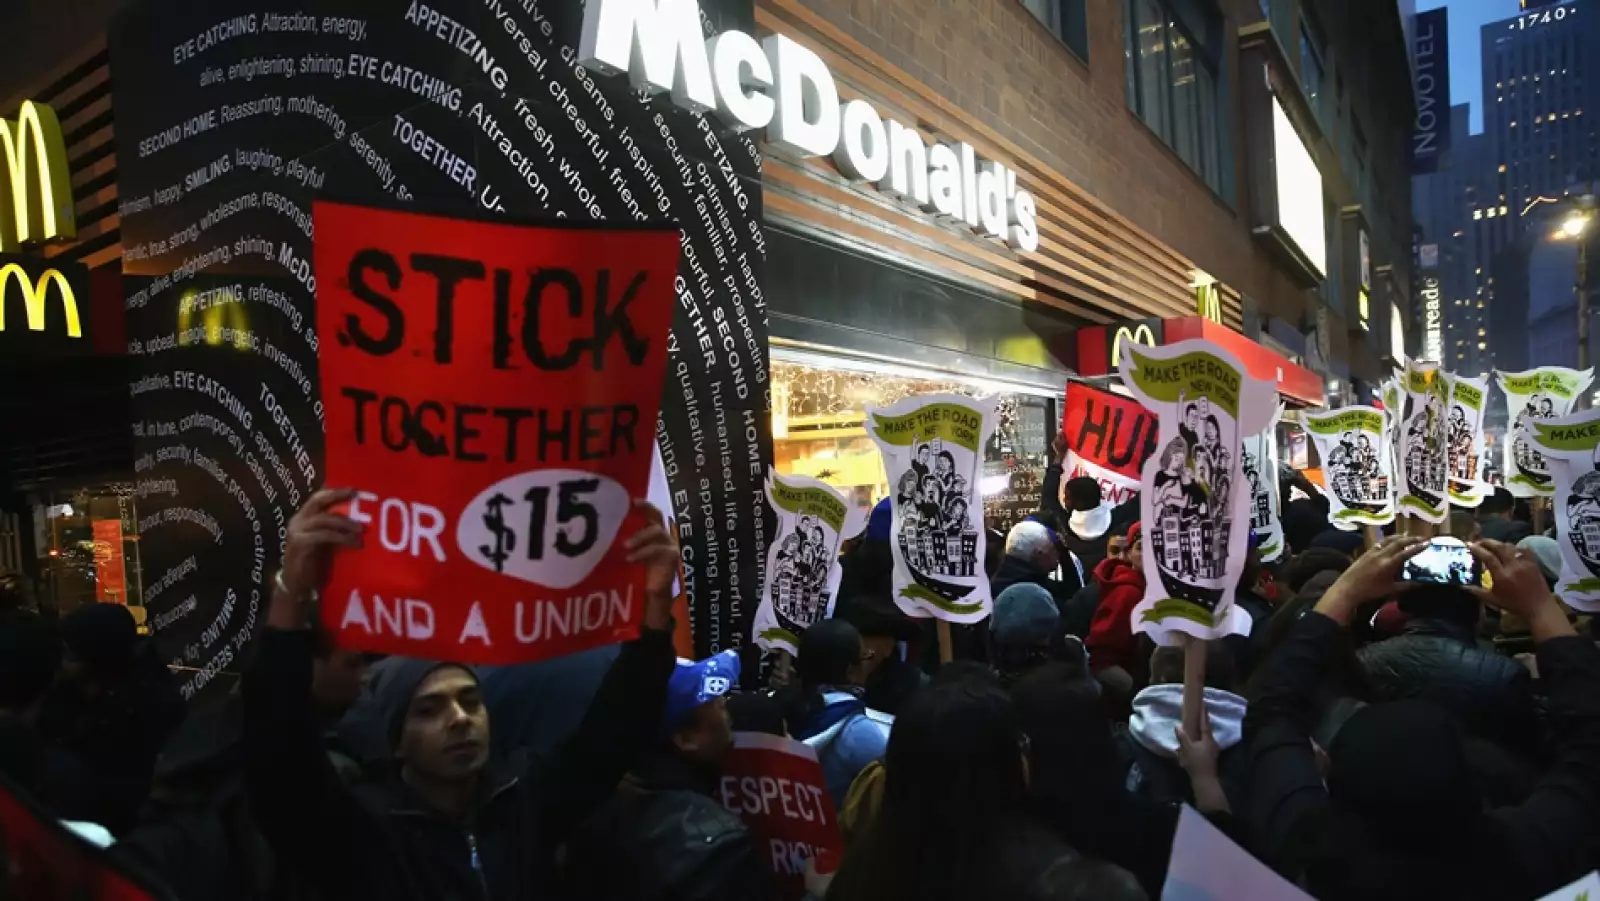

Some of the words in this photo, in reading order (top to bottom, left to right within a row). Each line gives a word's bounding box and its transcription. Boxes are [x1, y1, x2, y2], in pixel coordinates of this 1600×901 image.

[173, 39, 196, 64] EYE
[348, 53, 379, 79] EYE
[1412, 24, 1437, 158] NOVOTEL
[139, 127, 182, 158] SECOND
[579, 0, 1038, 253] McDonald's
[337, 248, 651, 371] STICK
[674, 274, 718, 374] GETHER,
[711, 306, 749, 400] SECOND
[1143, 362, 1182, 385] MAKE
[1181, 359, 1206, 378] THE
[1206, 360, 1238, 393] ROAD
[173, 370, 195, 390] EYE
[340, 387, 641, 463] TOGETHER
[884, 419, 916, 434] MAKE
[916, 407, 941, 425] THE
[942, 408, 978, 429] ROAD
[1550, 424, 1597, 441] MAKE
[348, 490, 447, 562] FOR
[477, 478, 602, 572] $15
[674, 488, 694, 540] EYE
[341, 588, 435, 639] AND
[459, 601, 493, 646] A
[514, 584, 634, 643] UNION
[719, 775, 827, 826] ESPECT
